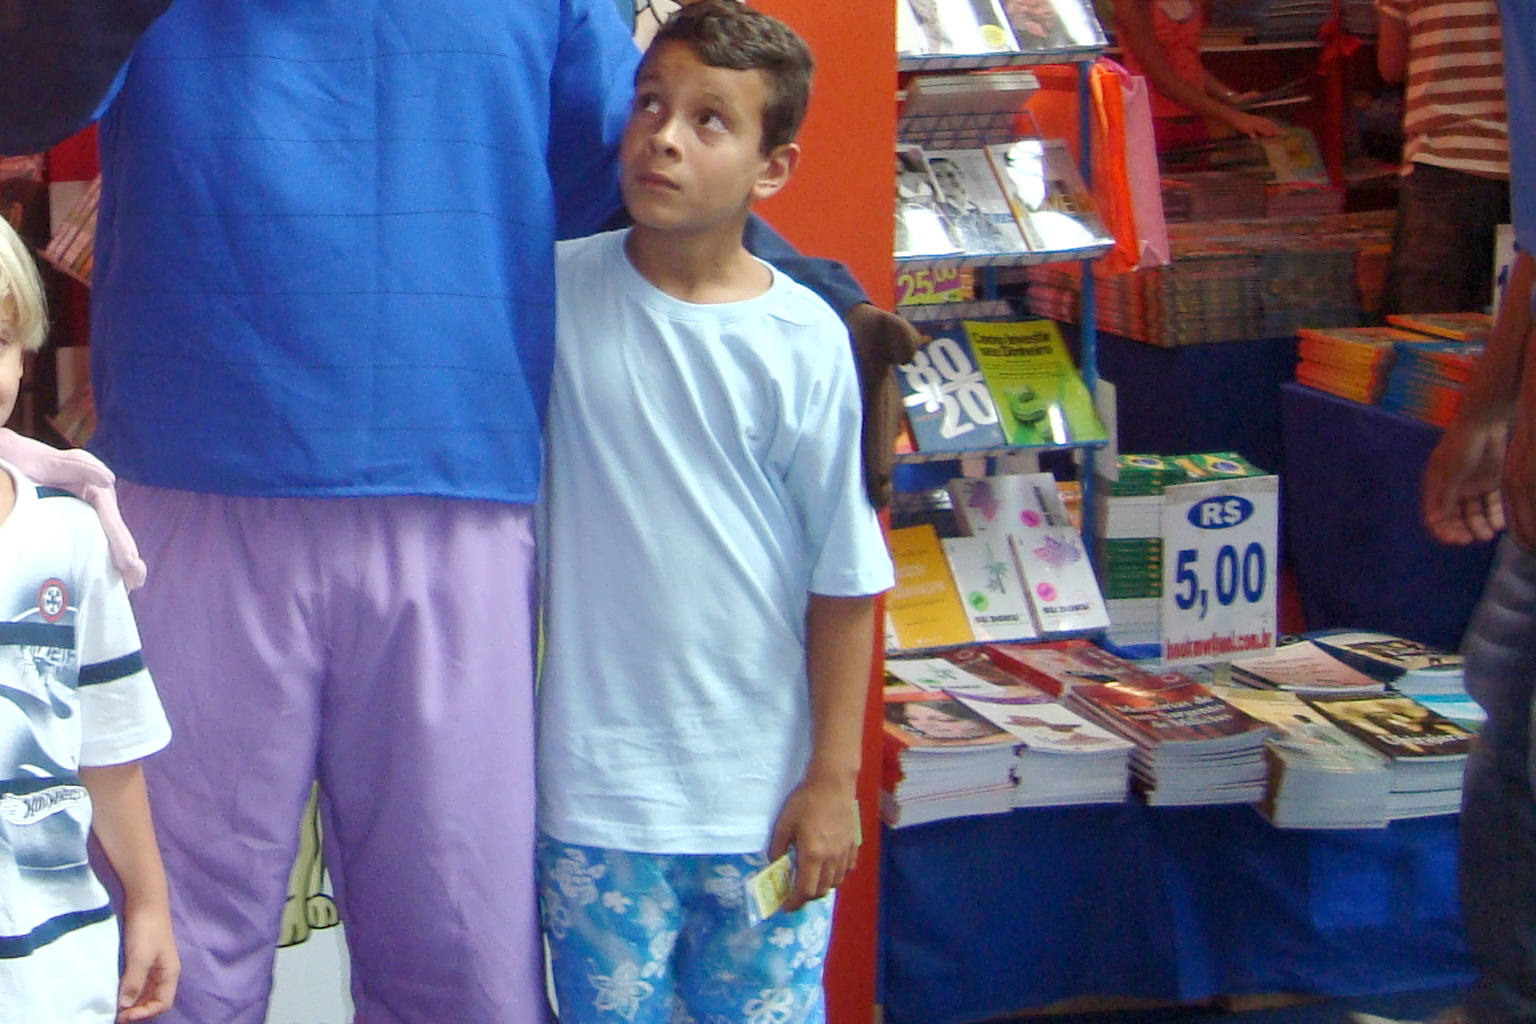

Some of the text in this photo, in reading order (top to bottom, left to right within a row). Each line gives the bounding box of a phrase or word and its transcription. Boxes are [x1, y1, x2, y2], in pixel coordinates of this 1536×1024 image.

[899, 338, 973, 394] 80
[939, 381, 998, 440] 20
[1175, 542, 1266, 621] 5,00
